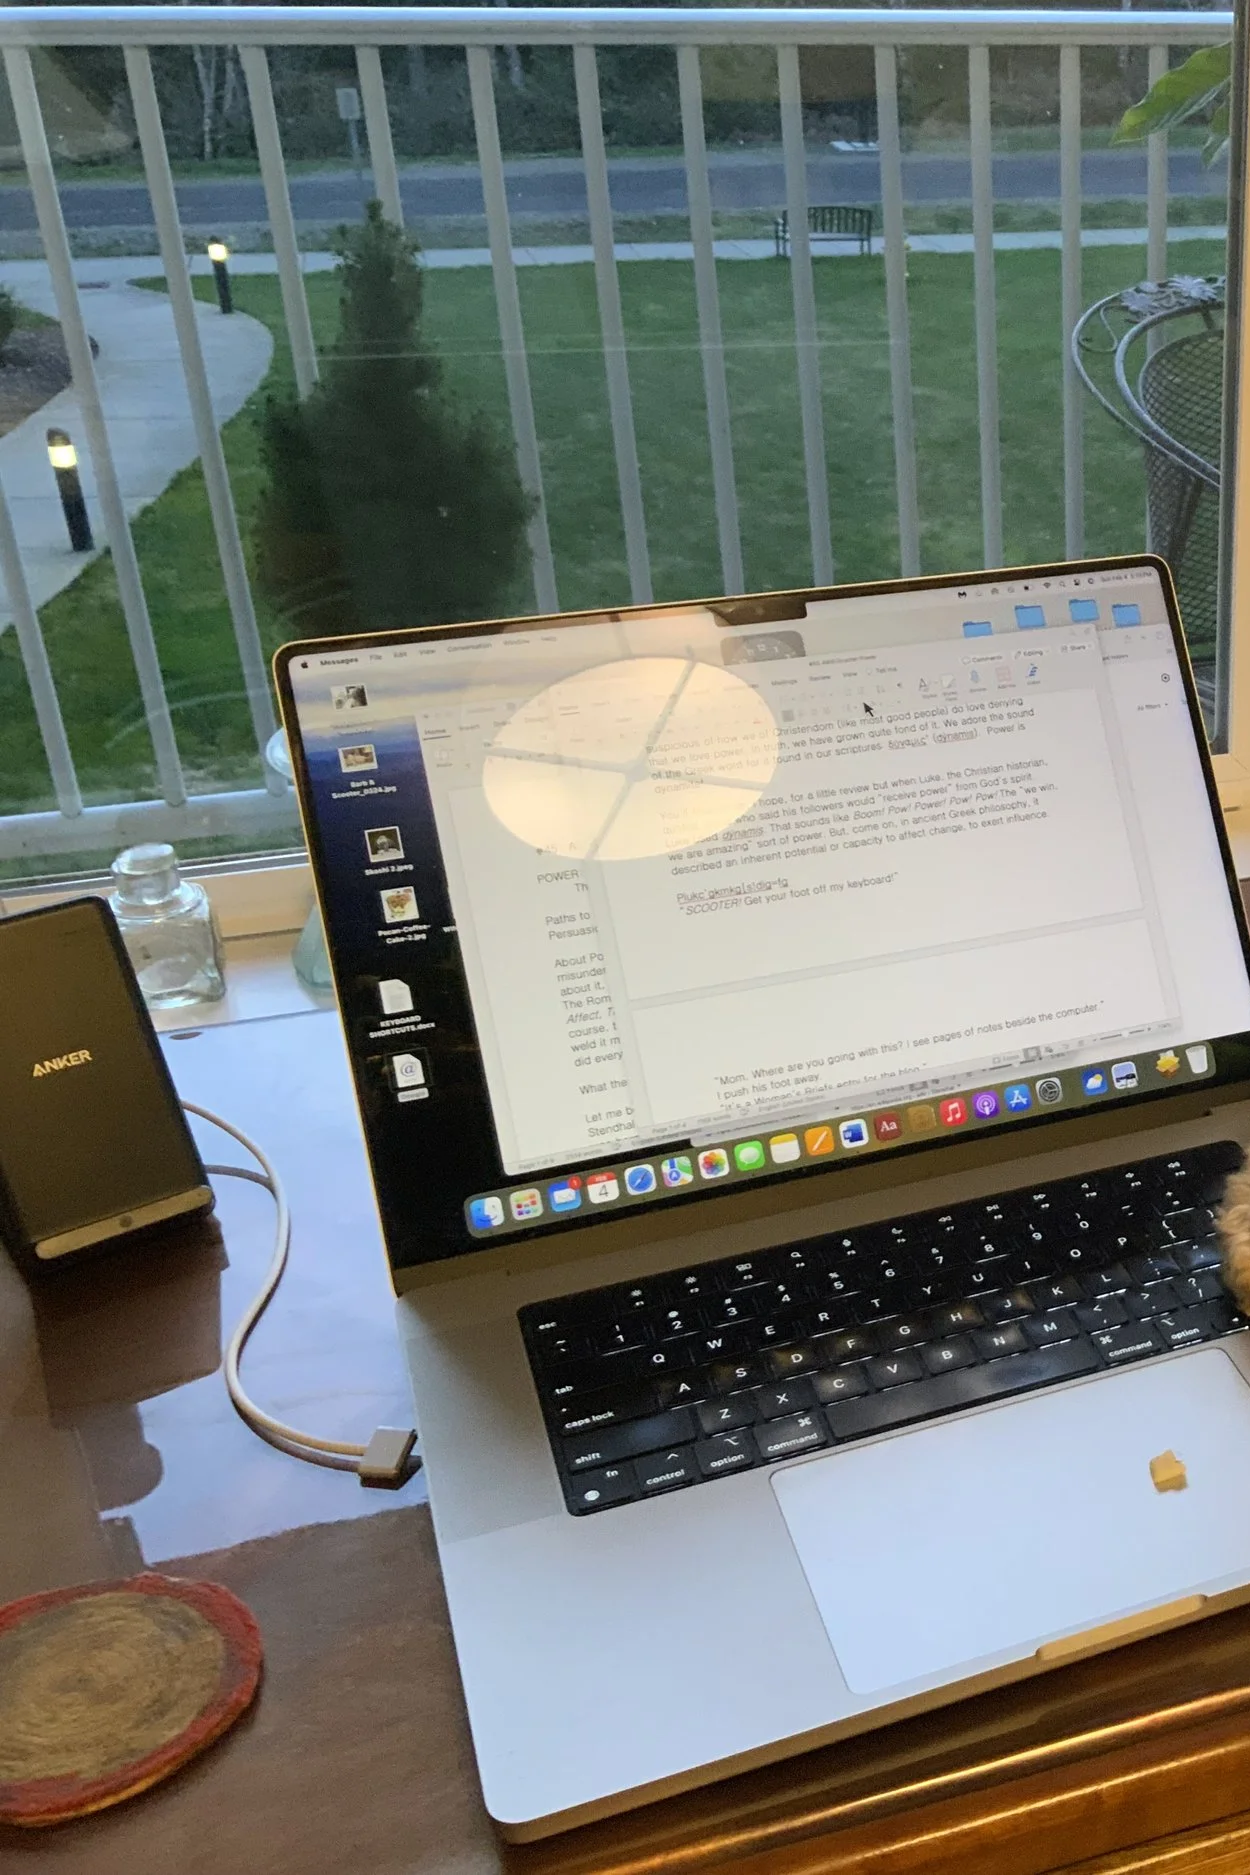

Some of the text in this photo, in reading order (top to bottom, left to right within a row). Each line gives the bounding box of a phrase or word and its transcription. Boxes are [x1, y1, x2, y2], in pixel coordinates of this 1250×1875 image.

[769, 722, 834, 738] Christendom
[859, 714, 884, 725] most
[886, 711, 912, 724] good
[951, 705, 964, 714] do
[965, 703, 986, 712] love
[987, 698, 1024, 709] denying
[790, 793, 804, 804] for
[807, 792, 815, 800] a
[816, 789, 837, 798] little
[839, 785, 870, 795] review
[872, 780, 889, 791] but
[890, 778, 917, 788] when
[946, 771, 962, 780] the
[963, 765, 1004, 778] Christian
[735, 814, 756, 824] who
[758, 809, 780, 821] said
[781, 807, 797, 817] his
[799, 801, 844, 815] followers
[846, 796, 876, 807] would
[955, 782, 978, 792] from
[768, 821, 792, 832] That
[794, 817, 831, 829] sounds
[832, 814, 850, 823] like
[999, 789, 1017, 798] The
[667, 850, 684, 861] we
[686, 850, 704, 859] are
[756, 837, 777, 849] sort
[779, 834, 789, 845] of
[851, 823, 880, 834] come
[900, 818, 910, 826] in
[911, 812, 947, 825] ancient
[948, 808, 977, 819] Greek
[1032, 797, 1040, 806] it
[671, 860, 723, 876] described
[725, 859, 738, 868] an
[740, 851, 782, 865] inherent
[784, 843, 827, 860] potential
[829, 843, 839, 852] or
[842, 836, 883, 849] capacity
[885, 834, 897, 843] to
[898, 828, 926, 841] affect
[968, 821, 979, 830] to
[981, 816, 1004, 828] exert
[537, 869, 579, 884] POWER
[743, 895, 762, 906] Get
[764, 892, 787, 904] your
[789, 887, 811, 898] foot
[812, 884, 827, 895] off
[829, 883, 844, 892] my
[545, 912, 591, 926] Paths to
[554, 955, 587, 968] About
[560, 984, 591, 997] about
[562, 1000, 583, 1009] The
[380, 1015, 421, 1028] KEYBOARD
[369, 1022, 435, 1038] SHORTCUTS.docx
[570, 1038, 607, 1052] weld it
[751, 1066, 784, 1079] Where
[787, 1063, 804, 1072] are
[805, 1059, 825, 1070] you
[827, 1052, 856, 1066] going
[857, 1047, 879, 1058] with
[906, 1040, 910, 1048] I
[912, 1037, 930, 1048] see
[932, 1031, 962, 1044] pages
[963, 1026, 974, 1037] of
[977, 1023, 1004, 1034] notes
[1005, 1016, 1037, 1029] beside
[1038, 1013, 1053, 1022] the
[32, 1049, 92, 1078] ANKER
[574, 1056, 592, 1067] did
[579, 1082, 607, 1095] What
[716, 1091, 722, 1100] I
[723, 1086, 749, 1101] push
[751, 1082, 768, 1093] his
[770, 1078, 792, 1089] foot
[585, 1109, 623, 1124] Let me
[587, 1119, 636, 1138] Stendhal
[880, 1120, 898, 1132] Aa
[599, 1184, 609, 1197] 4
[1118, 1237, 1127, 1246] P
[972, 1273, 984, 1282] U
[1101, 1274, 1112, 1282] L
[922, 1286, 931, 1294] Y
[1052, 1286, 1063, 1295] K
[871, 1298, 880, 1307] T
[1004, 1299, 1012, 1308] J
[818, 1312, 829, 1321] R
[950, 1312, 962, 1322] H
[539, 1322, 556, 1330] esc
[765, 1325, 775, 1335] E
[899, 1326, 911, 1335] G
[1043, 1322, 1057, 1332] M
[1171, 1328, 1200, 1339] option
[707, 1338, 722, 1349] W
[847, 1339, 855, 1348] F
[993, 1336, 1005, 1346] N
[1109, 1340, 1152, 1357] command
[653, 1354, 665, 1363] Q
[791, 1354, 803, 1363] D
[942, 1350, 953, 1360] B
[735, 1368, 747, 1377] S
[886, 1364, 897, 1373] V
[679, 1383, 691, 1393] A
[833, 1379, 844, 1388] C
[555, 1386, 573, 1394] tab
[776, 1393, 788, 1404] X
[719, 1408, 731, 1419] Z
[565, 1411, 614, 1429] caps lock
[767, 1433, 818, 1451] command
[575, 1453, 601, 1464] shift
[710, 1454, 744, 1467] option
[646, 1469, 685, 1485] control
